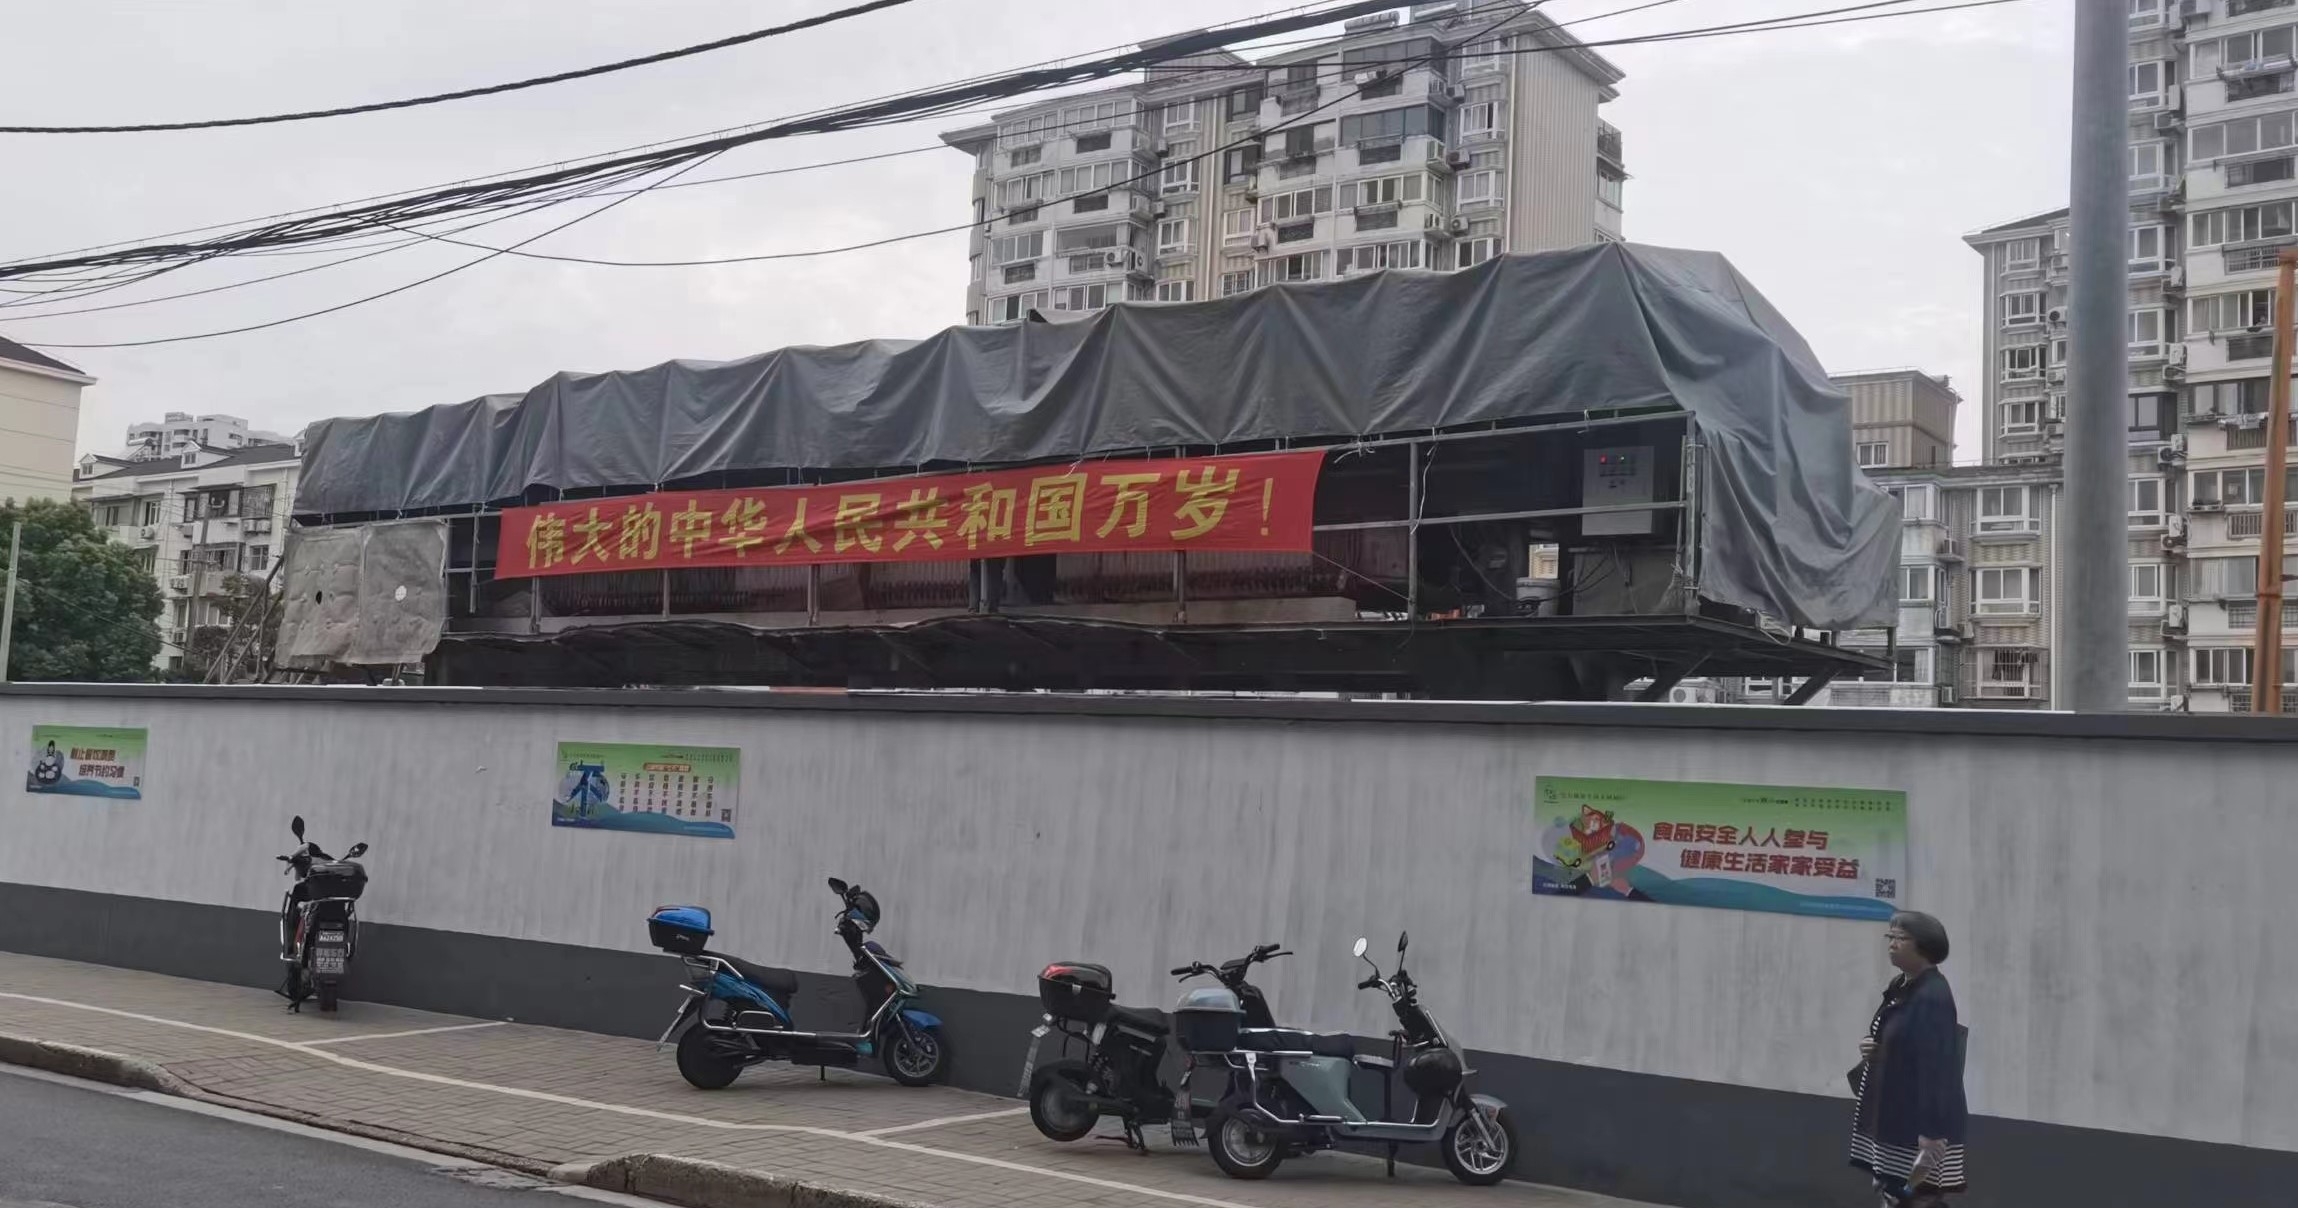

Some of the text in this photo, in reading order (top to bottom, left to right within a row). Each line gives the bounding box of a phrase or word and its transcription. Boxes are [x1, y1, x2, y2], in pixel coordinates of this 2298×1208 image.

[1652, 821, 1829, 851] 食品安全人人参与
[1680, 848, 1859, 880] 健康生活家家受益
